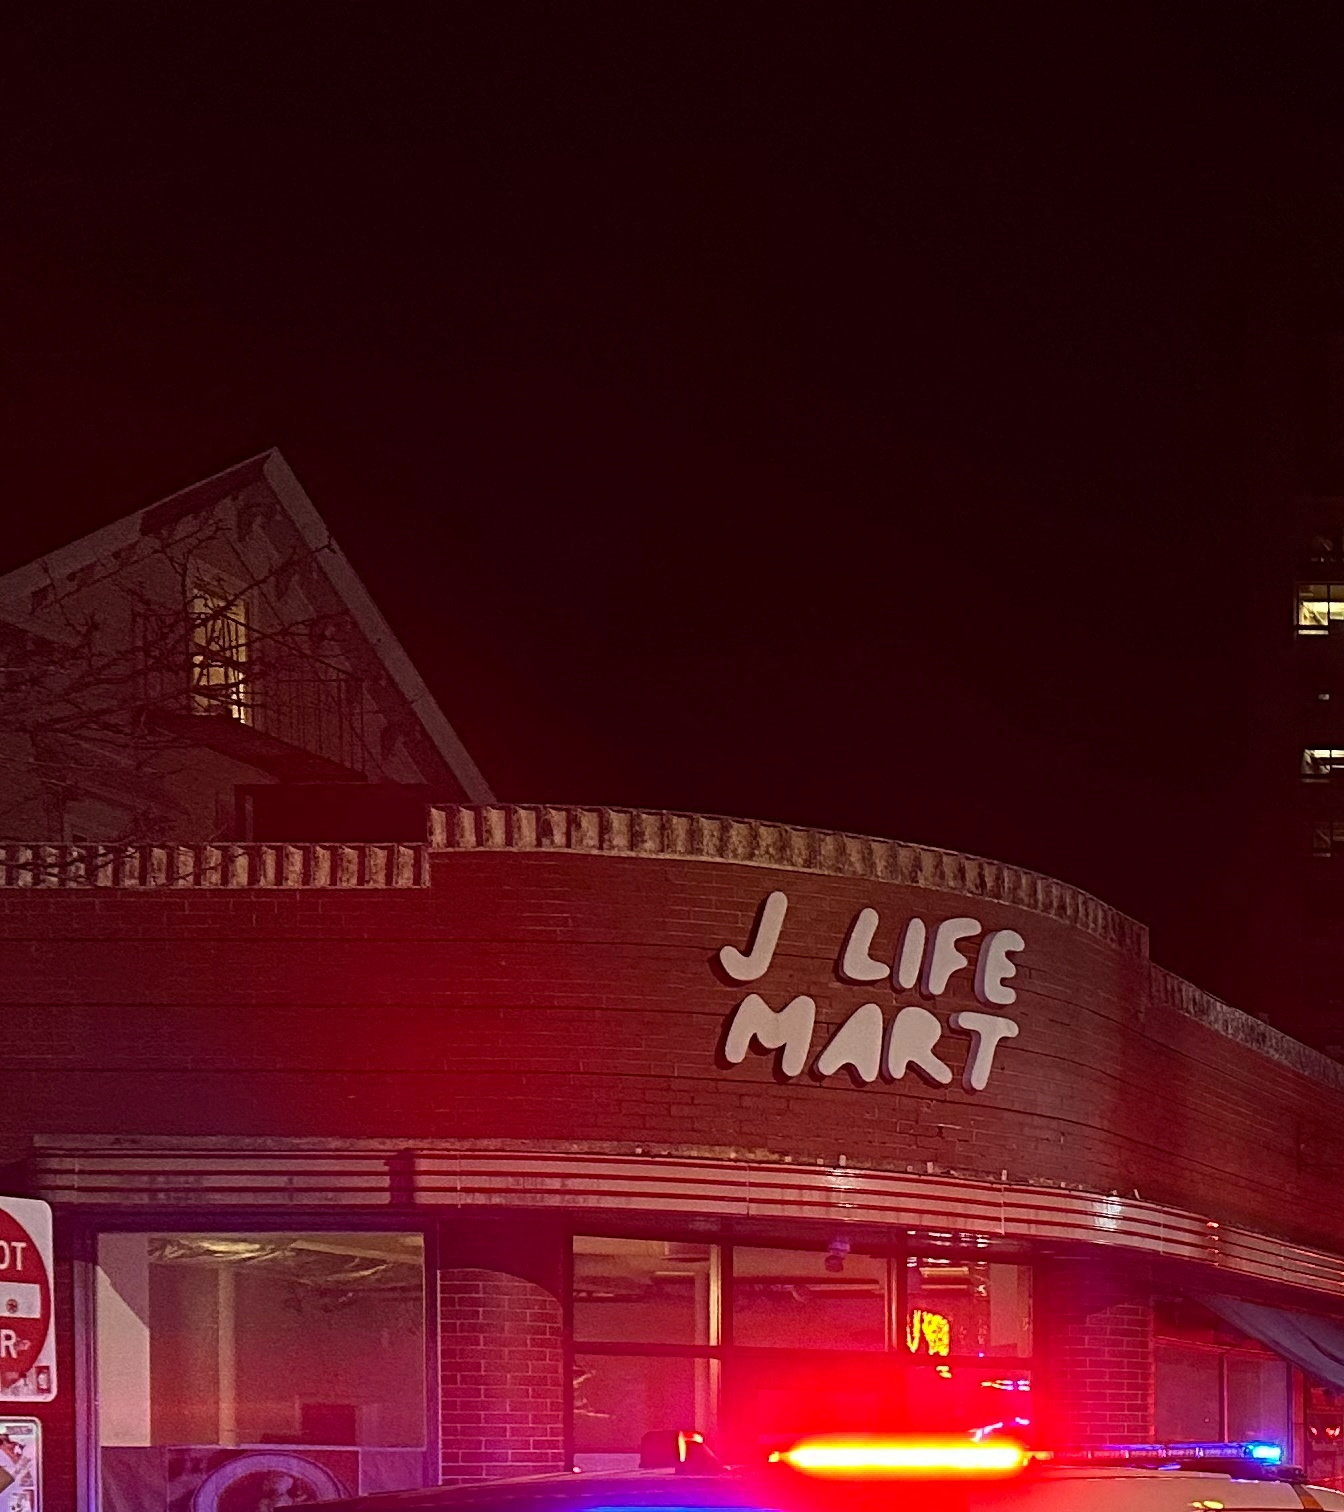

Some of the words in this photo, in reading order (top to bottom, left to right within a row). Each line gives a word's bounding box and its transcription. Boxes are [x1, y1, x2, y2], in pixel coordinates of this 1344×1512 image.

[719, 891, 788, 982] J
[841, 907, 1026, 1006] LIFE
[724, 992, 1019, 1092] MART
